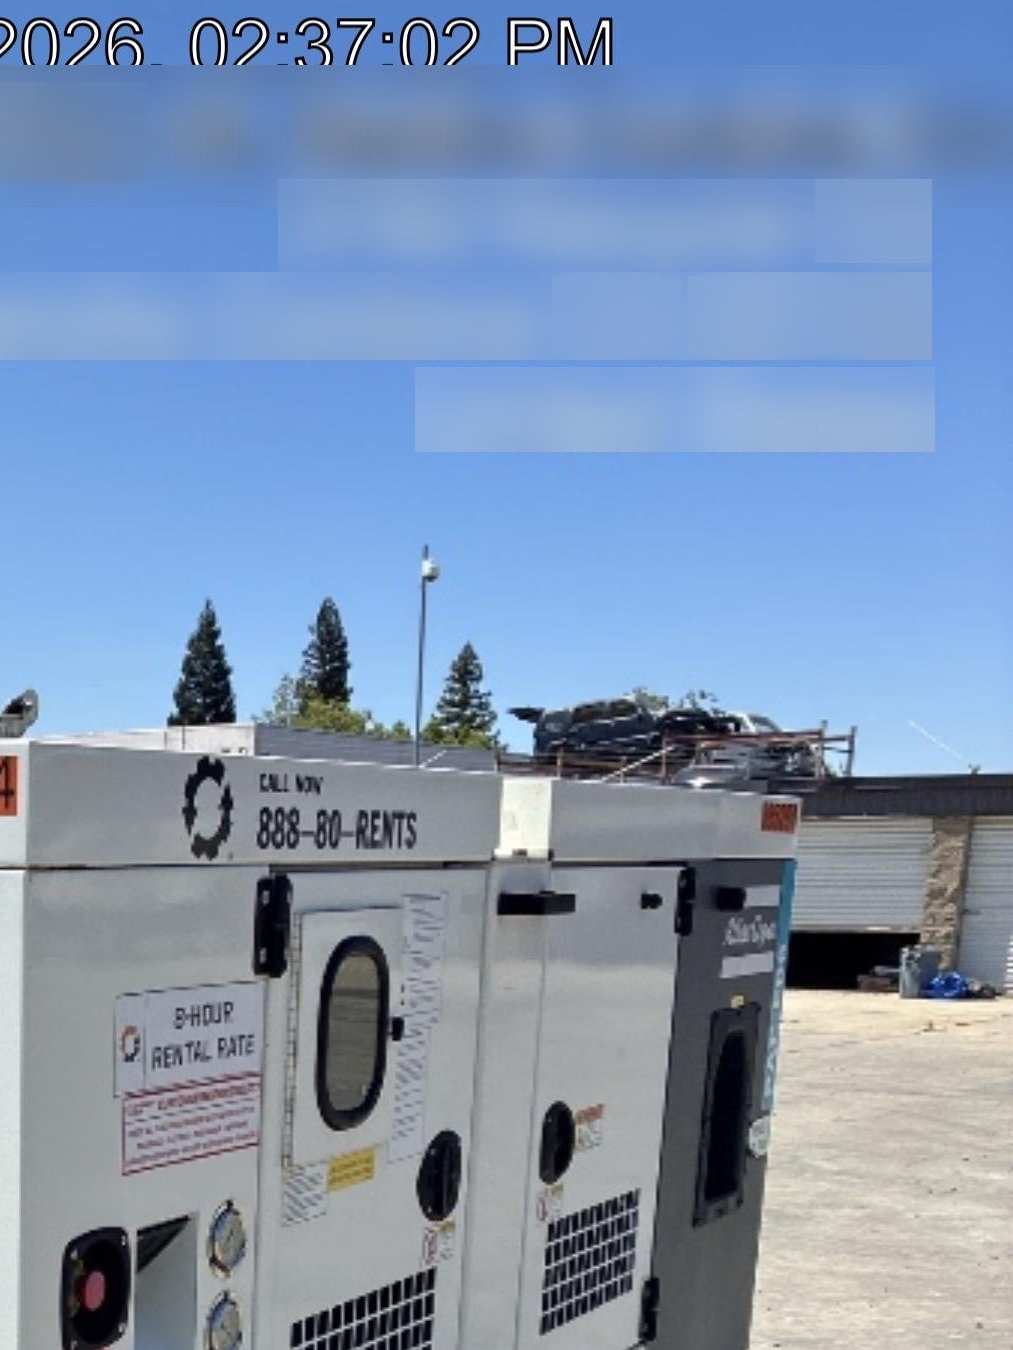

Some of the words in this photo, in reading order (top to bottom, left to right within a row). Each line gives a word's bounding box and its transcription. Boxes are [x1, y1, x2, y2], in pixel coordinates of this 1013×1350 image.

[259, 773, 290, 793] CALL
[295, 774, 324, 795] NOW
[257, 806, 418, 850] 888-80-RENTS
[174, 1001, 234, 1030] 8-HOUR
[151, 1040, 212, 1072] RENTAL
[217, 1033, 255, 1060] RATE
